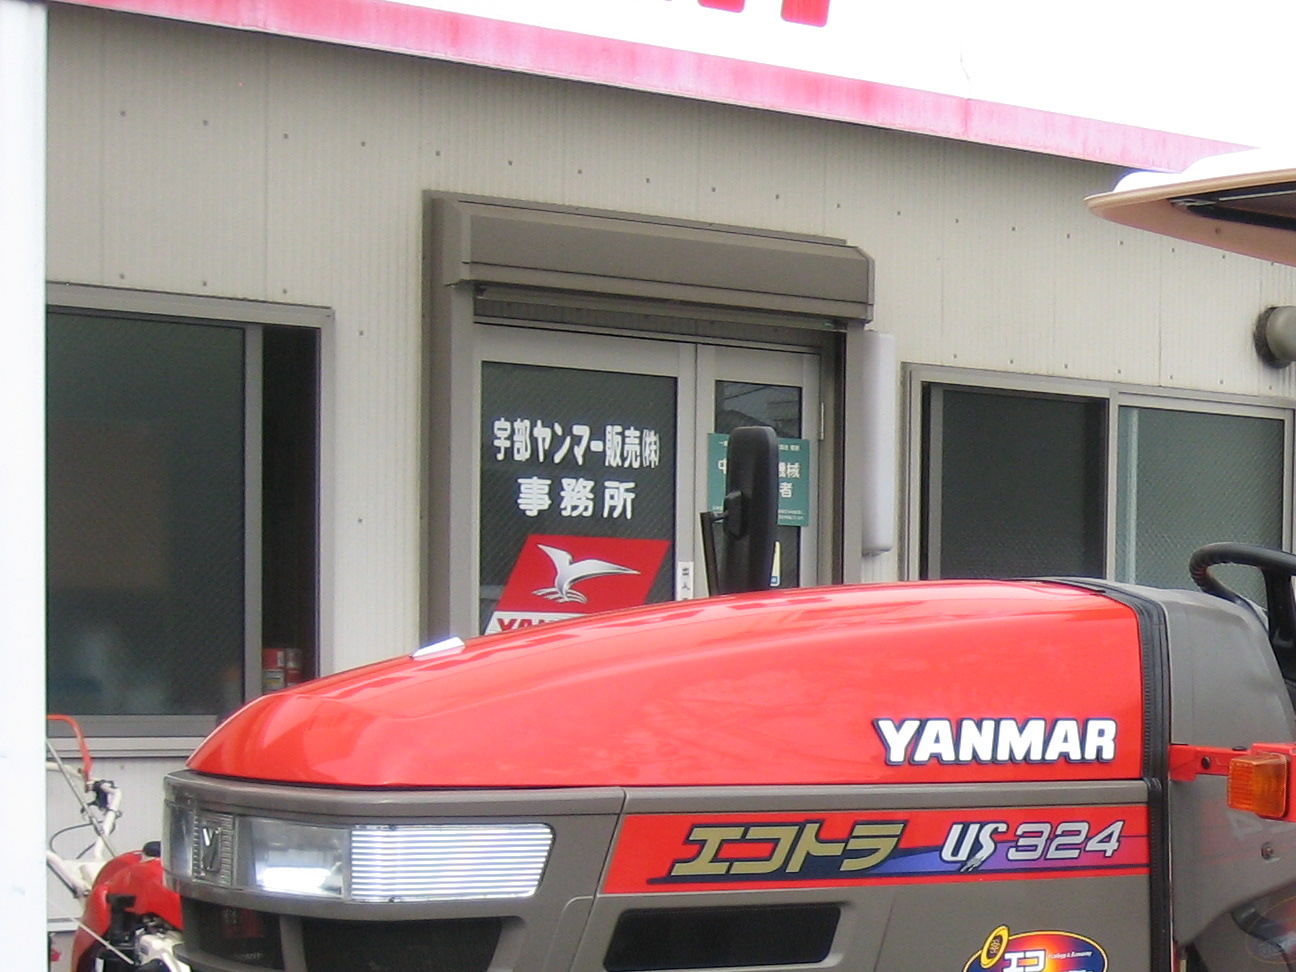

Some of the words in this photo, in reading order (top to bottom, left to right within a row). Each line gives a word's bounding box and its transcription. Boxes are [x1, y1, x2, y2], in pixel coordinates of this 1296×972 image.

[516, 476, 636, 520] 事務所
[873, 717, 1117, 765] YANMAR
[669, 819, 907, 877] エコトラ
